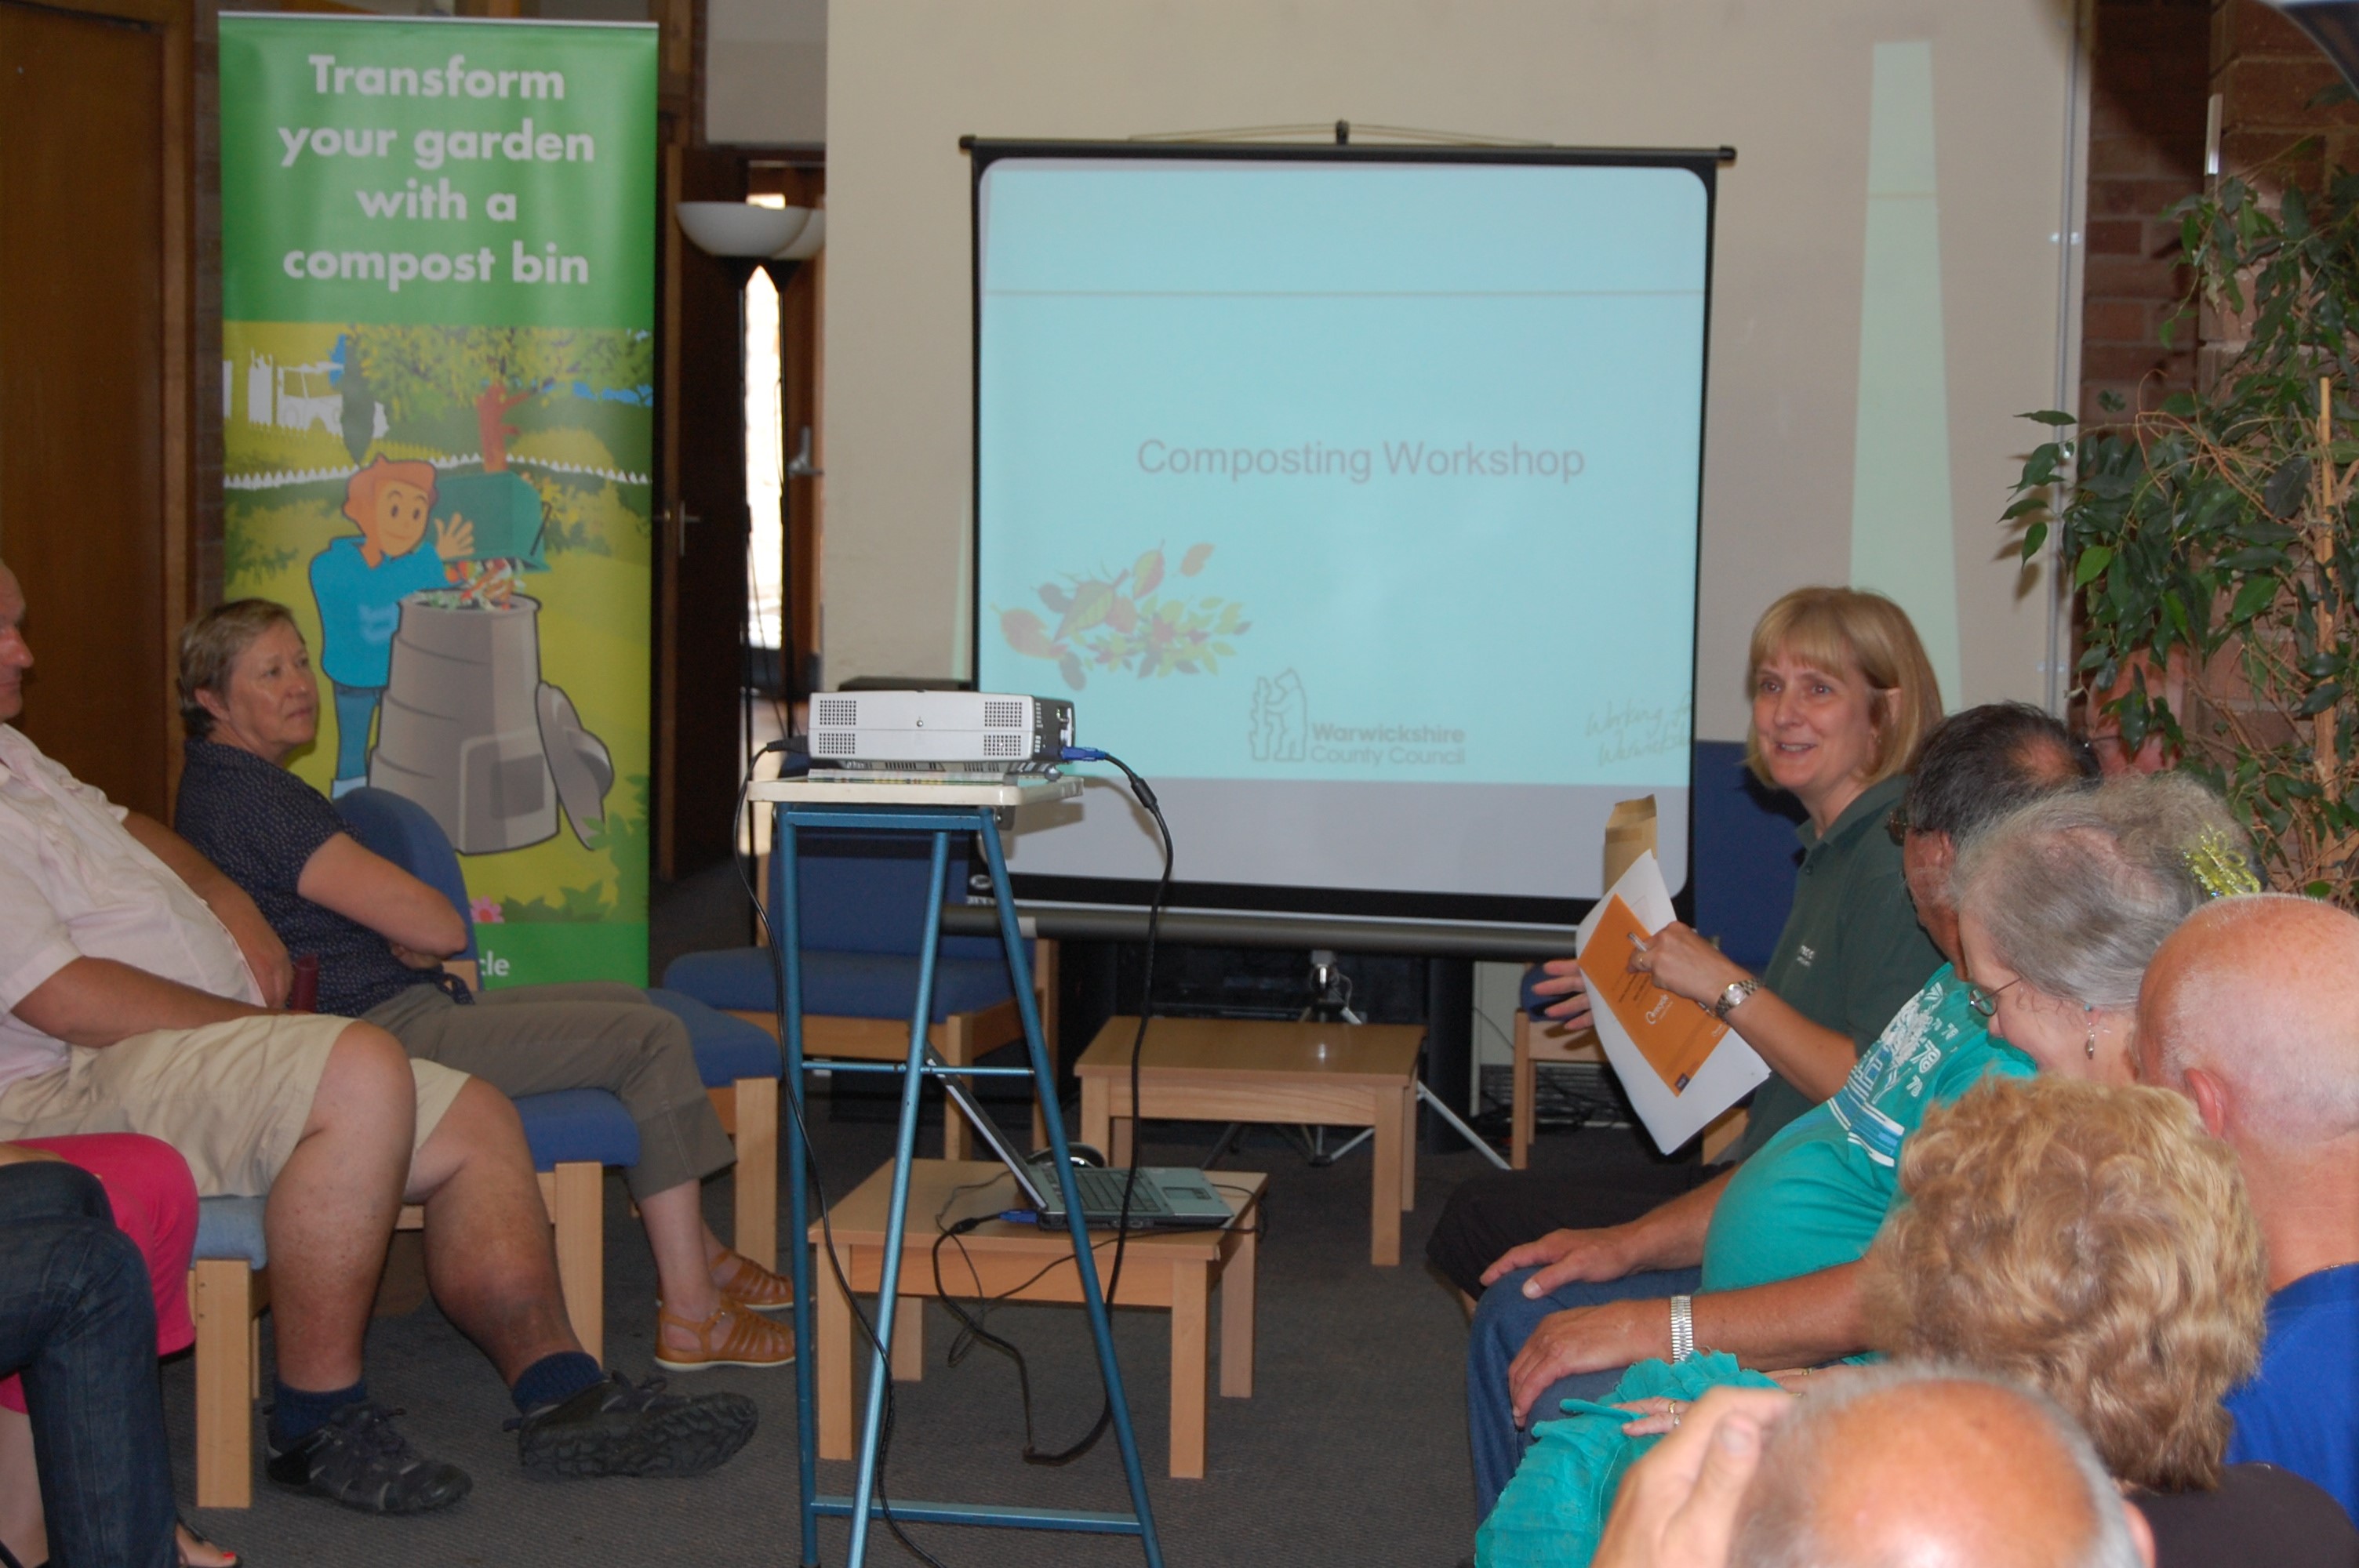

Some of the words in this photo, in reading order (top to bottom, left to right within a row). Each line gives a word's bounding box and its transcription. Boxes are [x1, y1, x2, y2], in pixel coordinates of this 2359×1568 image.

[309, 53, 565, 99] Transform
[278, 126, 398, 167] your
[414, 118, 594, 169] garden
[356, 178, 467, 220] with
[486, 193, 517, 221] a
[283, 247, 496, 292] compost
[513, 240, 589, 283] bin
[1137, 438, 1372, 484] Composting
[1383, 441, 1585, 484] Workshop
[1310, 746, 1385, 766] County
[1389, 746, 1466, 764] Council
[1311, 723, 1466, 743] Warwickshire
